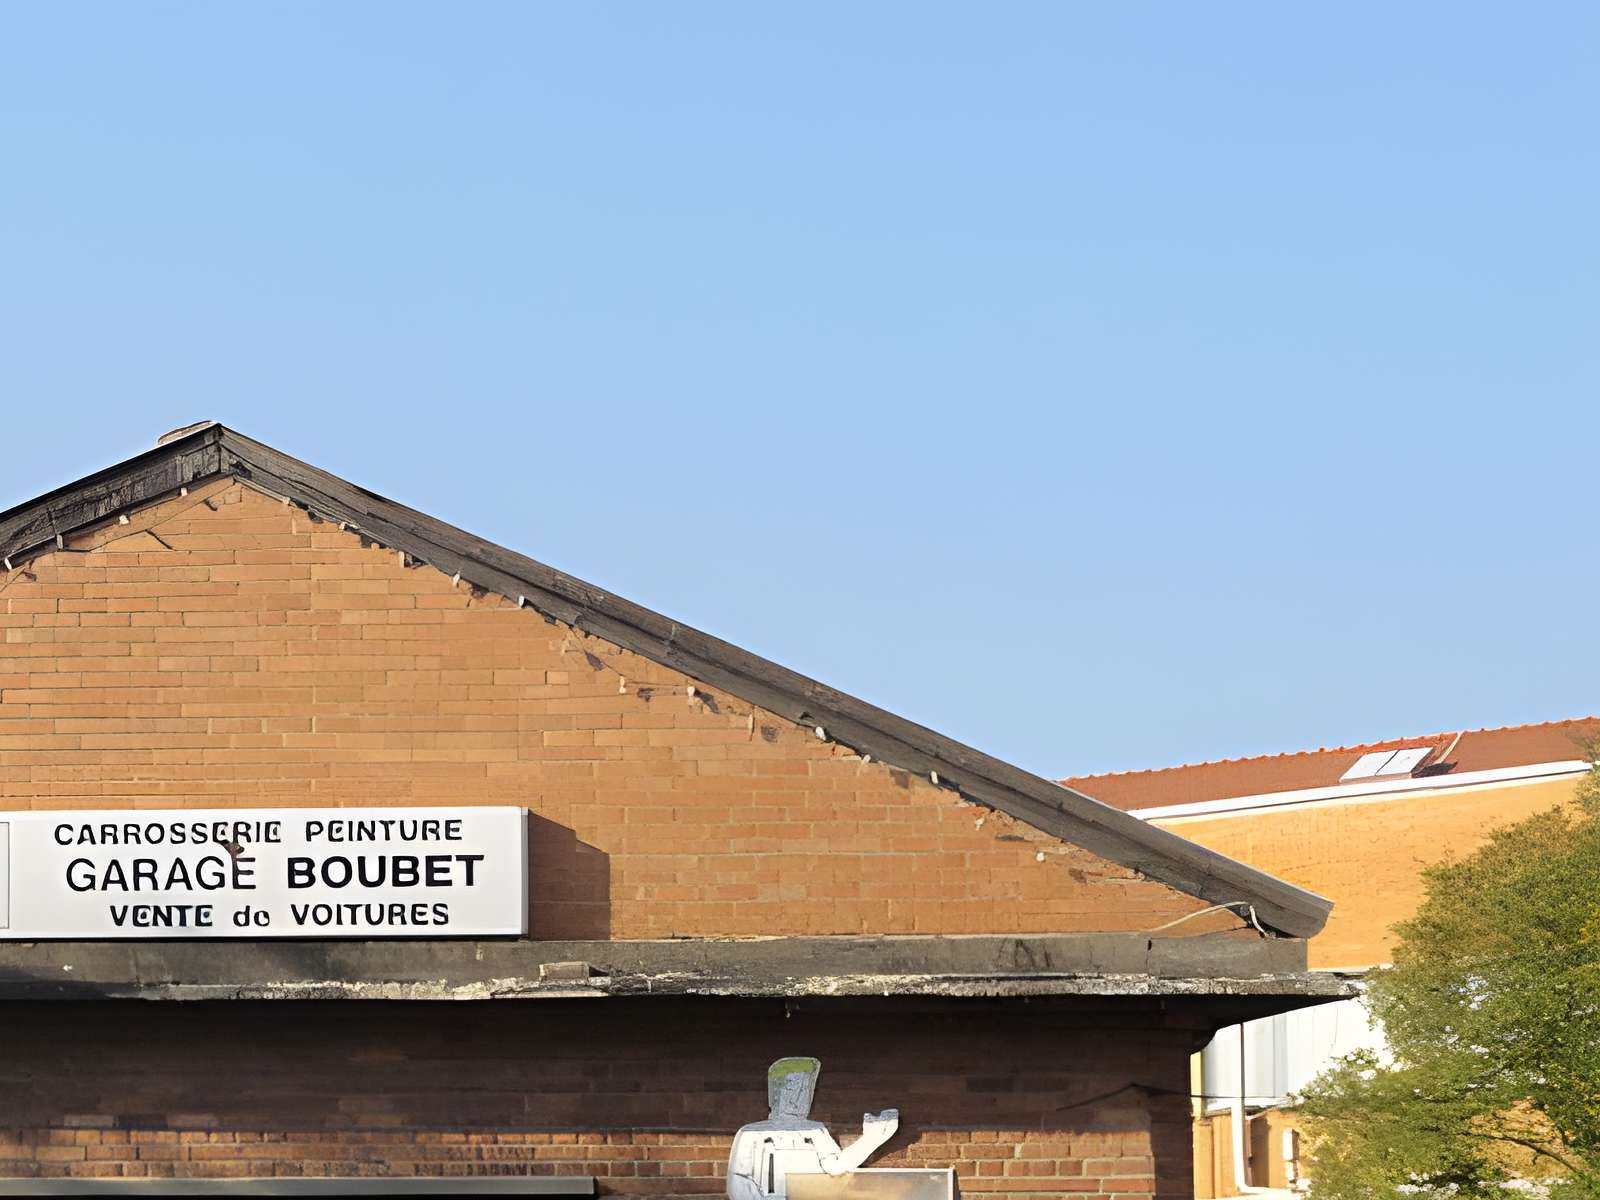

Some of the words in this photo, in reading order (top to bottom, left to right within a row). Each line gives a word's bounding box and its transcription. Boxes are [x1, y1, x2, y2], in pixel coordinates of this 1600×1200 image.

[54, 821, 281, 846] CARROSSERIE
[305, 819, 463, 842] PEINTURE
[66, 856, 257, 892] GARAGE
[287, 854, 485, 889] BOUBET
[110, 904, 213, 928] VENTE
[291, 903, 449, 926] VOITURES
